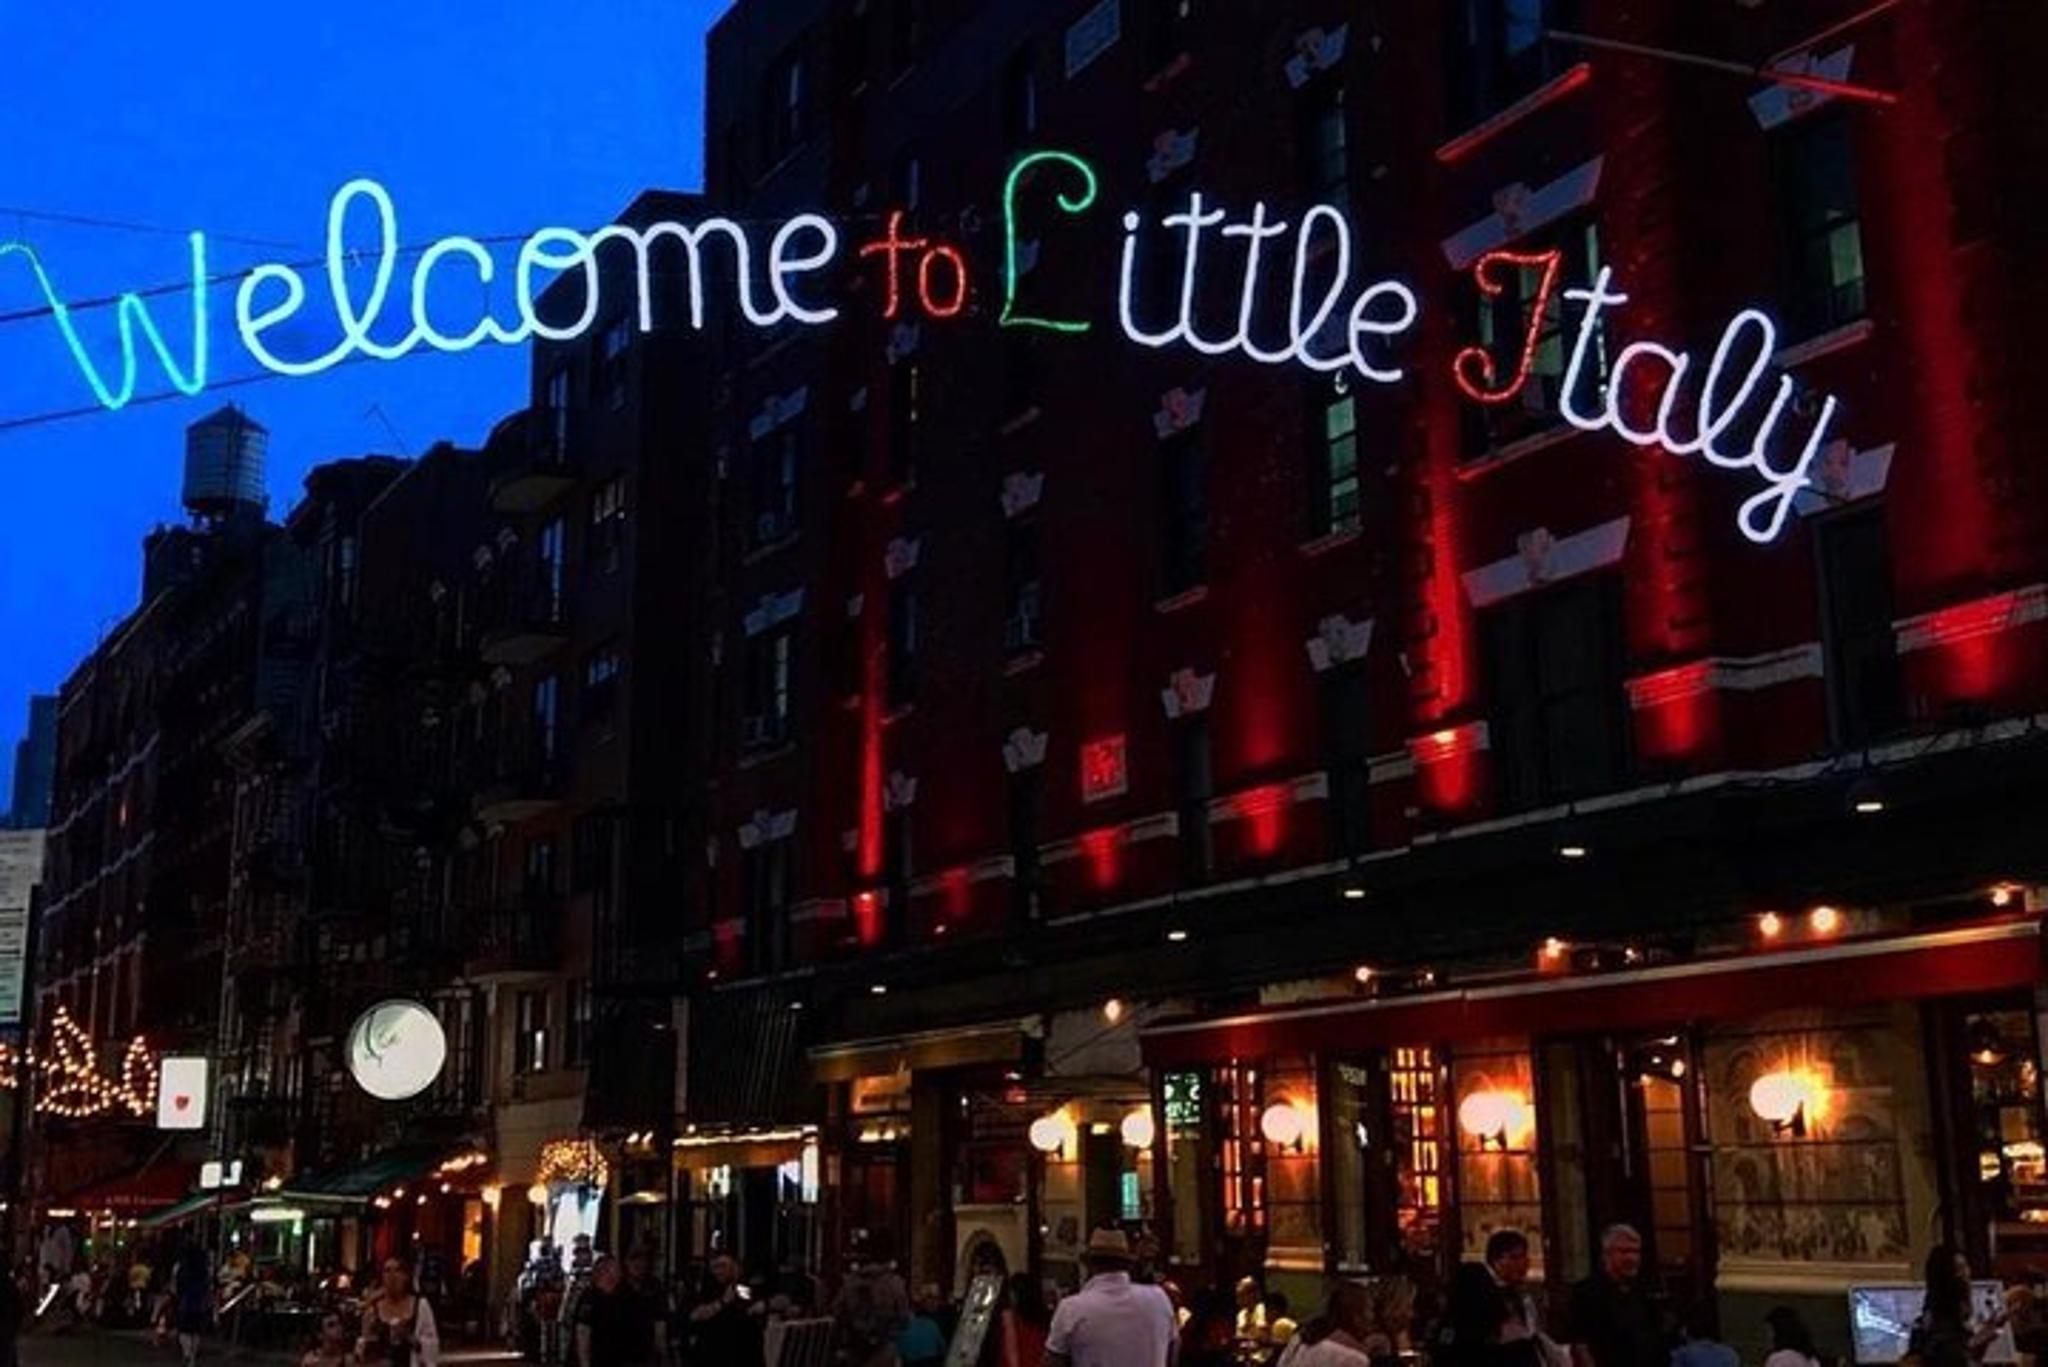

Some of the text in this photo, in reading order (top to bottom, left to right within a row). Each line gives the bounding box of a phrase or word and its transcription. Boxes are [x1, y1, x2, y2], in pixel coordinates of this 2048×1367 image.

[0, 151, 1838, 543] Welcome to Little Italy
